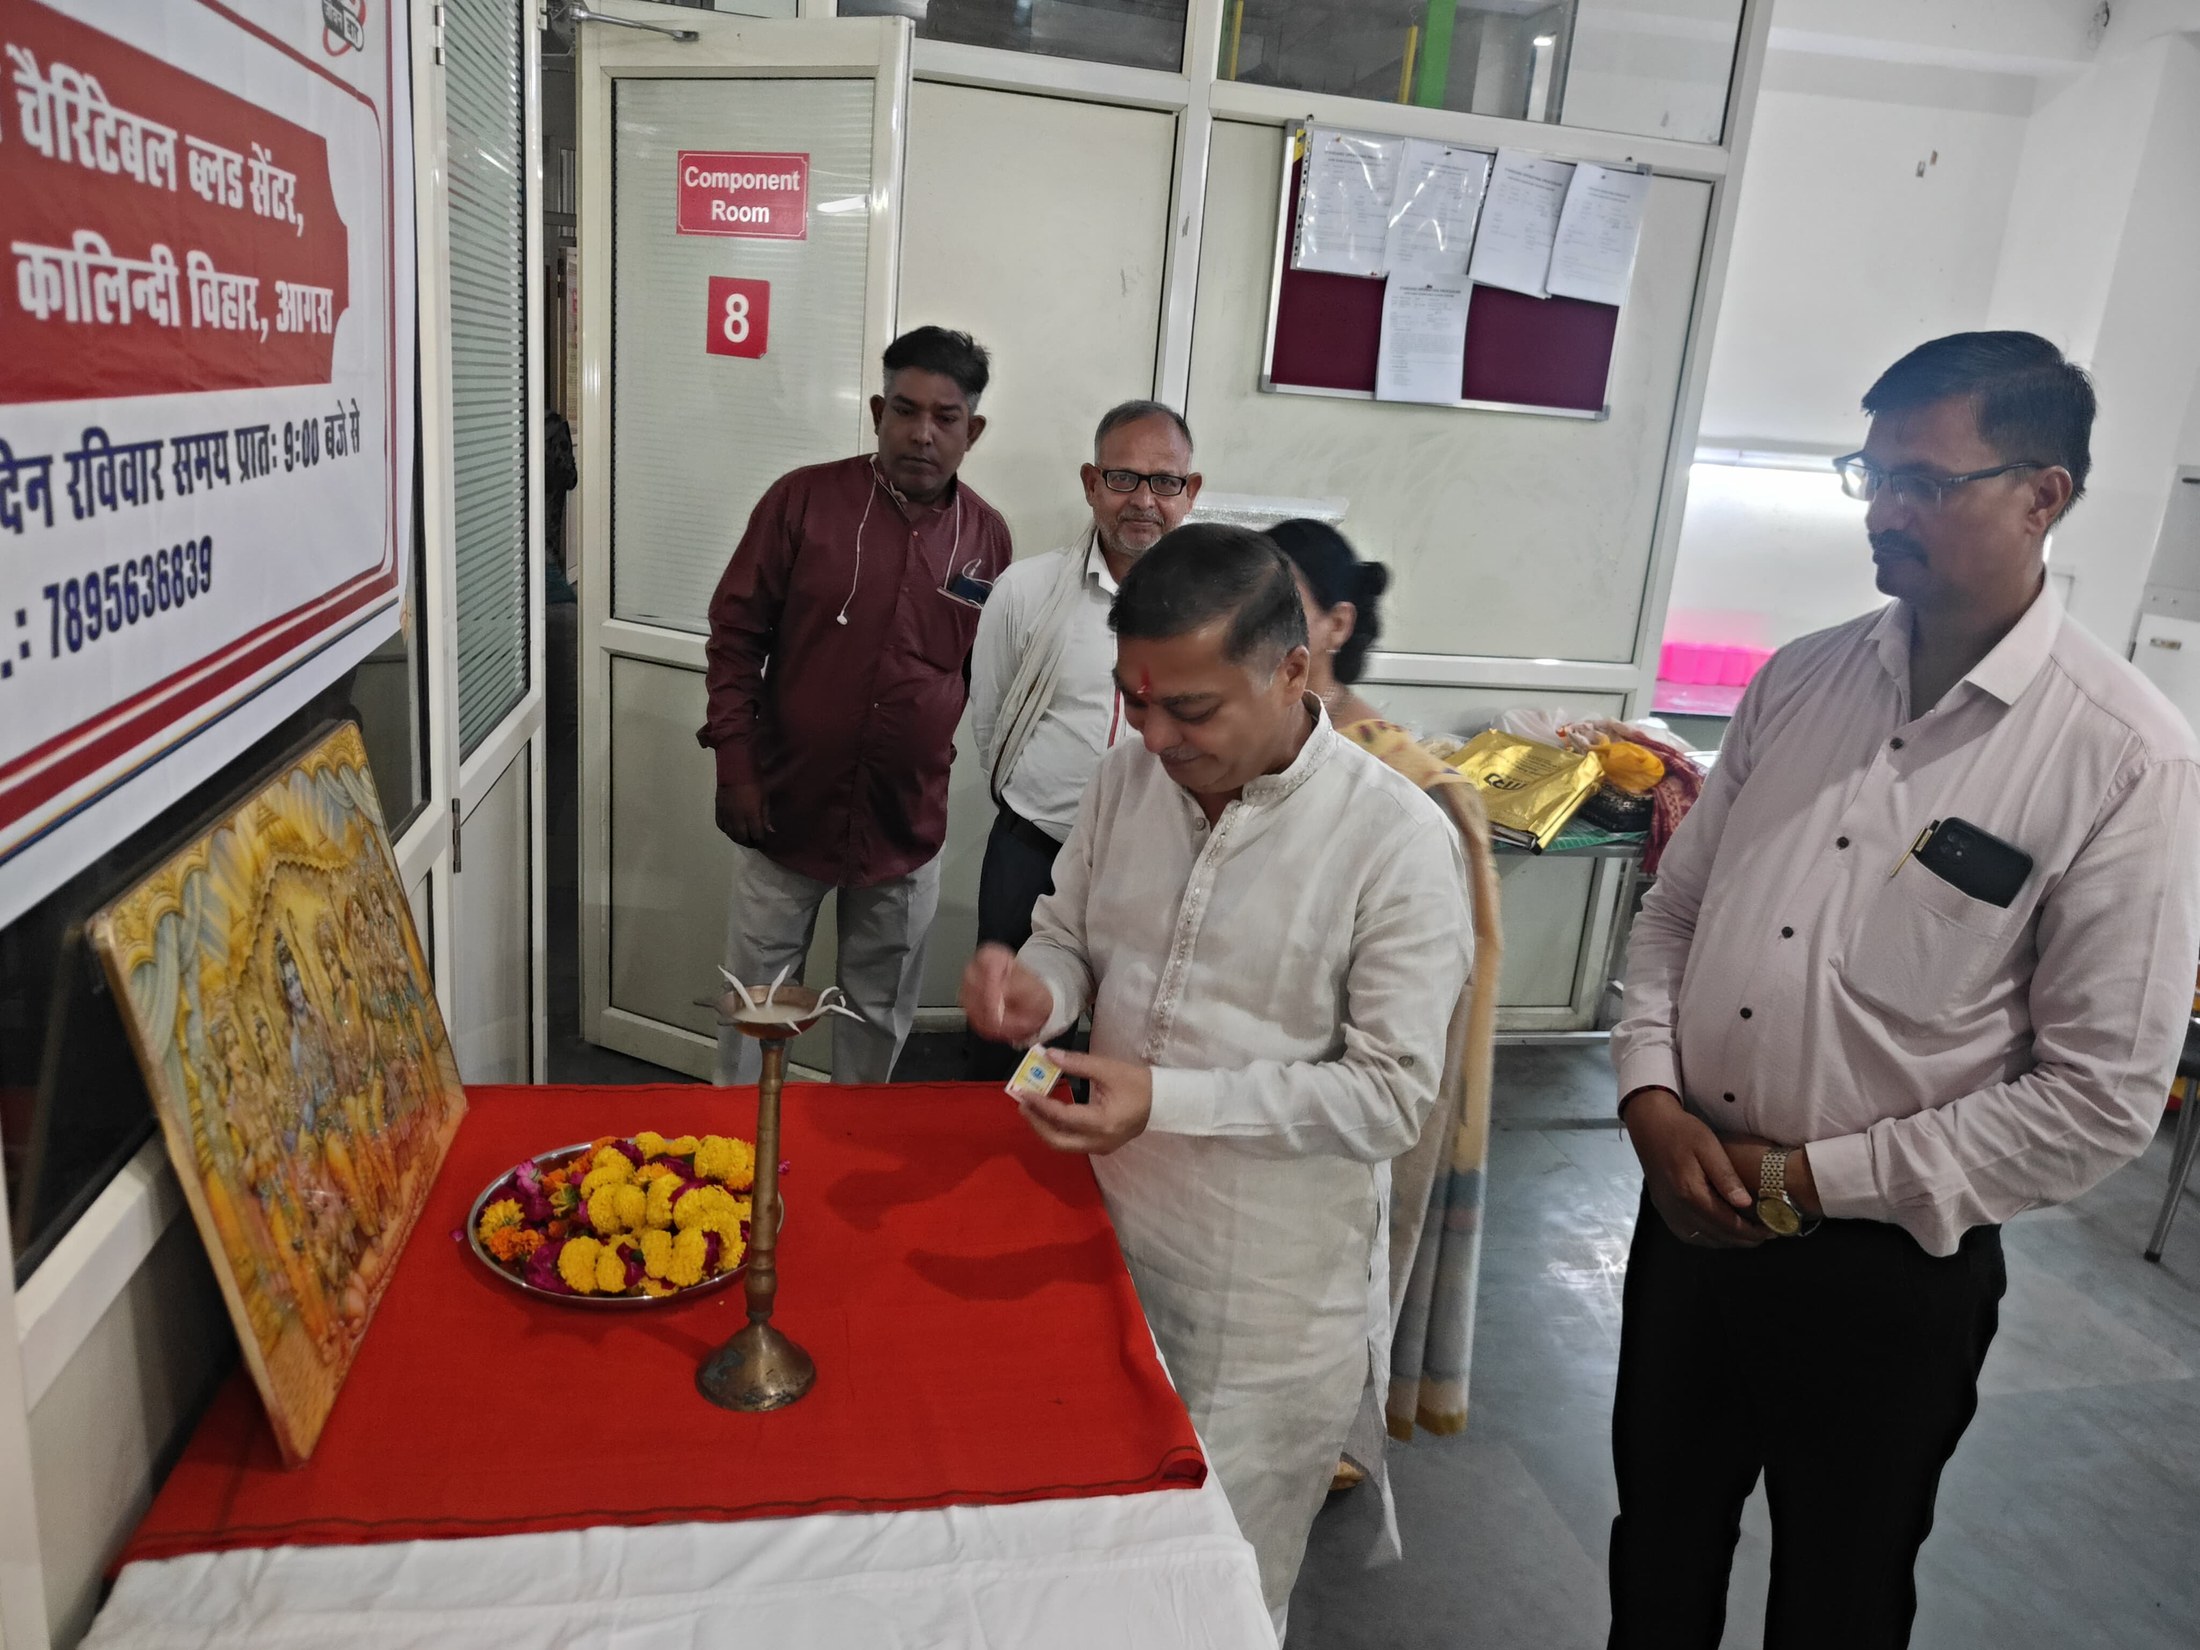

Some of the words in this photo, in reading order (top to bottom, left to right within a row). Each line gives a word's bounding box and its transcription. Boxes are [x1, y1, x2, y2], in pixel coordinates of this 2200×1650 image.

[247, 140, 305, 238] सेंटर,
[685, 166, 801, 193] Component
[711, 199, 770, 223] Room
[11, 229, 182, 328] कालिन्दी
[186, 249, 270, 344] विहार,
[274, 280, 334, 334] आगरा
[723, 293, 750, 343] 8
[63, 425, 165, 520] रविवार
[170, 429, 231, 496] समय
[284, 421, 320, 473] 9:00
[323, 399, 349, 460] बजे
[348, 397, 361, 454] से
[43, 535, 213, 660] 7895636839
